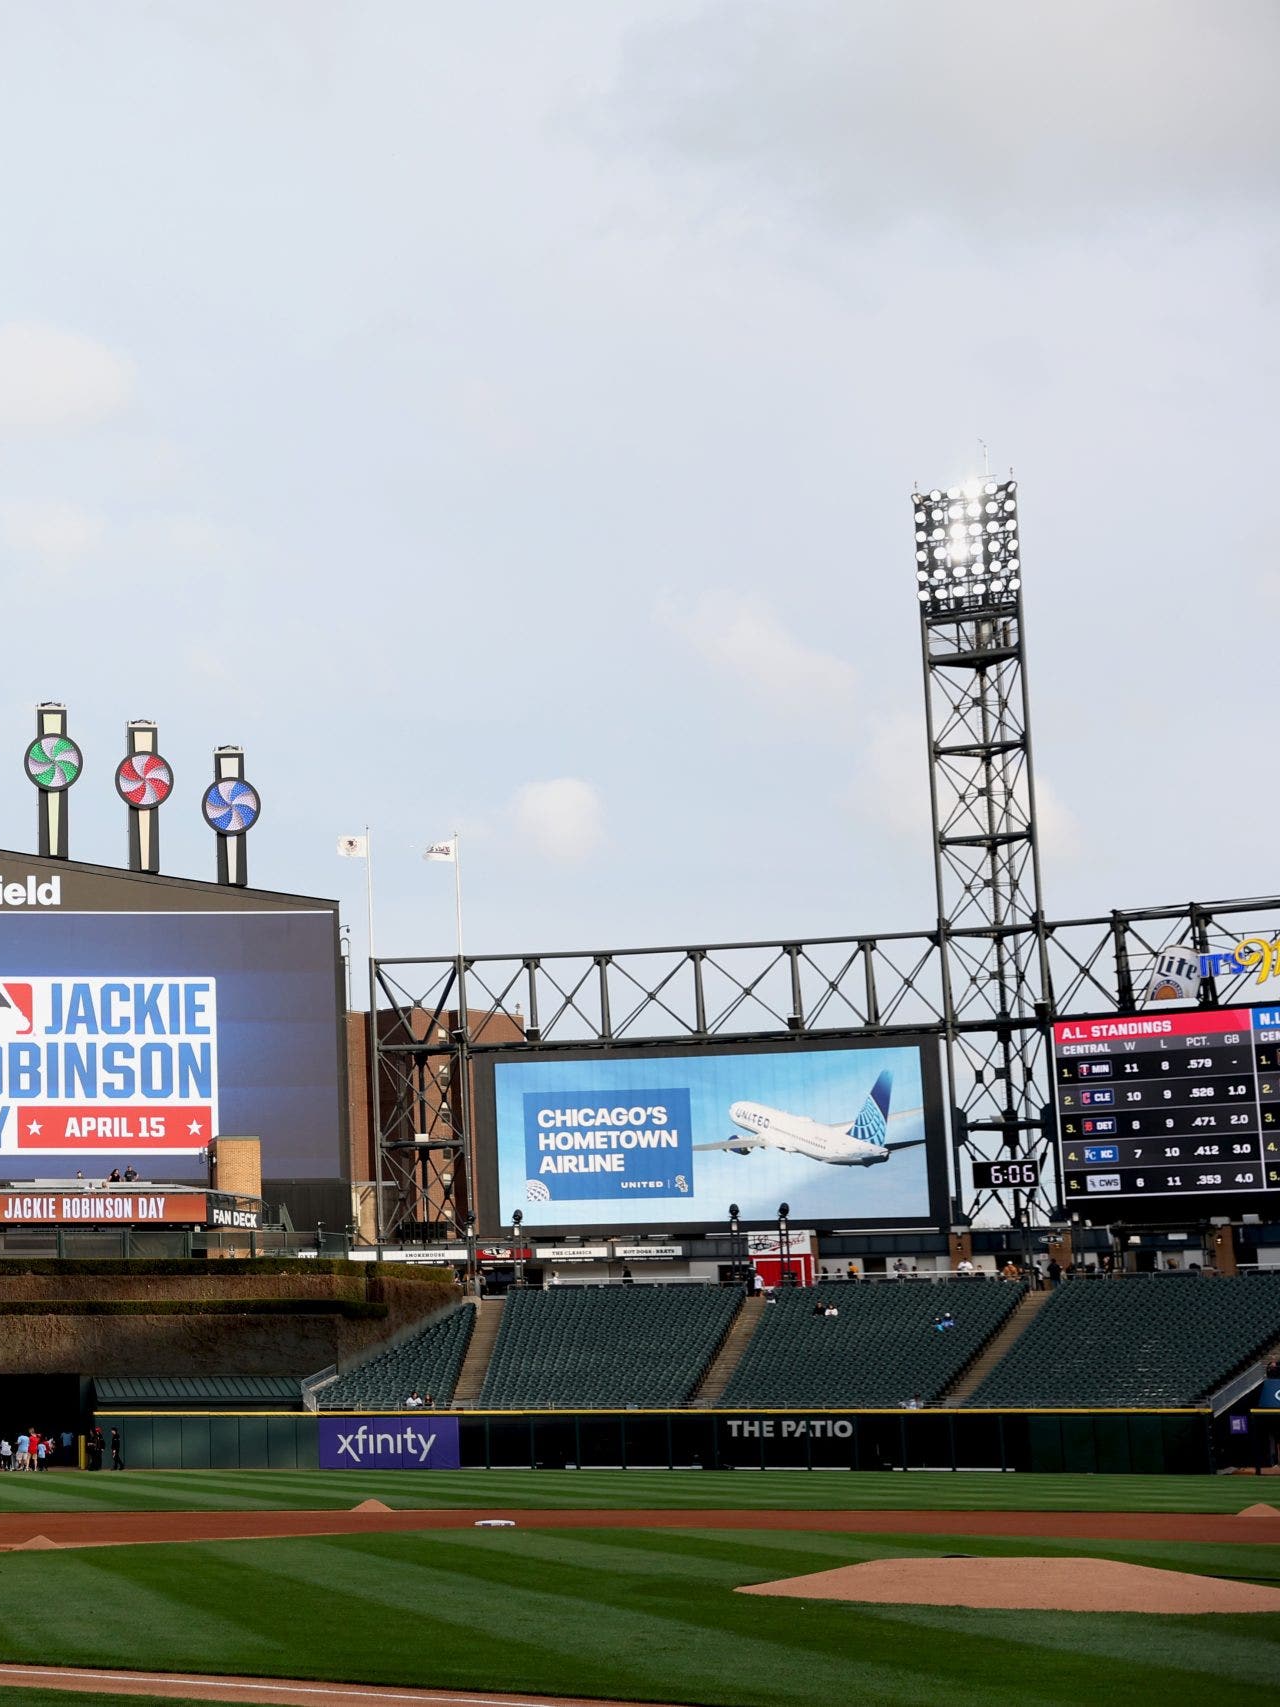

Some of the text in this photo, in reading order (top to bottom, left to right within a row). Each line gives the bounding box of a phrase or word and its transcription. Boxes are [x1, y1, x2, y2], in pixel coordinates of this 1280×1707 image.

[1157, 955, 1198, 980] Lite
[45, 983, 211, 1035] JACKIE
[1062, 1020, 1172, 1040] A.L. STANDINGS
[1062, 1033, 1240, 1055] CENTRAL W L PCT. GB
[1062, 1068, 1073, 1077] 1.
[1091, 1063, 1110, 1073] MIN
[1124, 1063, 1139, 1073] 11
[1161, 1061, 1170, 1070] 8
[1187, 1058, 1212, 1068] .579
[1260, 1055, 1271, 1065] 1.
[1064, 1096, 1074, 1105] 2.
[1093, 1092, 1111, 1102] CLE
[1126, 1091, 1142, 1101] 10
[1163, 1090, 1172, 1099] 9
[1189, 1087, 1214, 1097] .526
[1228, 1085, 1246, 1095] 1.0
[1262, 1083, 1273, 1093] 2.
[537, 1106, 668, 1128] CHICAGO'S
[735, 1107, 770, 1129] UNITED
[1066, 1124, 1076, 1133] 3.
[1096, 1121, 1113, 1130] DET
[1132, 1120, 1140, 1130] 8
[1165, 1118, 1174, 1128] 9
[1191, 1116, 1216, 1126] .471
[1230, 1114, 1248, 1124] 2.0
[1264, 1113, 1276, 1122] 3.
[65, 1117, 133, 1138] APRIL
[138, 1117, 166, 1138] 15
[538, 1130, 678, 1151] HOMETOWN
[1068, 1152, 1078, 1161] 4.
[1100, 1150, 1114, 1159] KC
[1134, 1149, 1142, 1159] 7
[1164, 1147, 1180, 1157] 10
[1194, 1145, 1219, 1155] .412
[1232, 1144, 1251, 1154] 3.0
[539, 1154, 625, 1174] AIRLINE
[991, 1165, 1035, 1184] 6:06
[1070, 1173, 1254, 1189] 5. CWS 6 11 .353 4.0
[621, 1181, 664, 1189] UNITED
[4, 1198, 56, 1219] JACKIE
[62, 1198, 132, 1219] ROBINSON
[138, 1198, 166, 1219] DAY
[213, 1208, 258, 1228] FAN DECK
[727, 1420, 853, 1438] THE PATIO
[337, 1425, 436, 1462] xfinity
